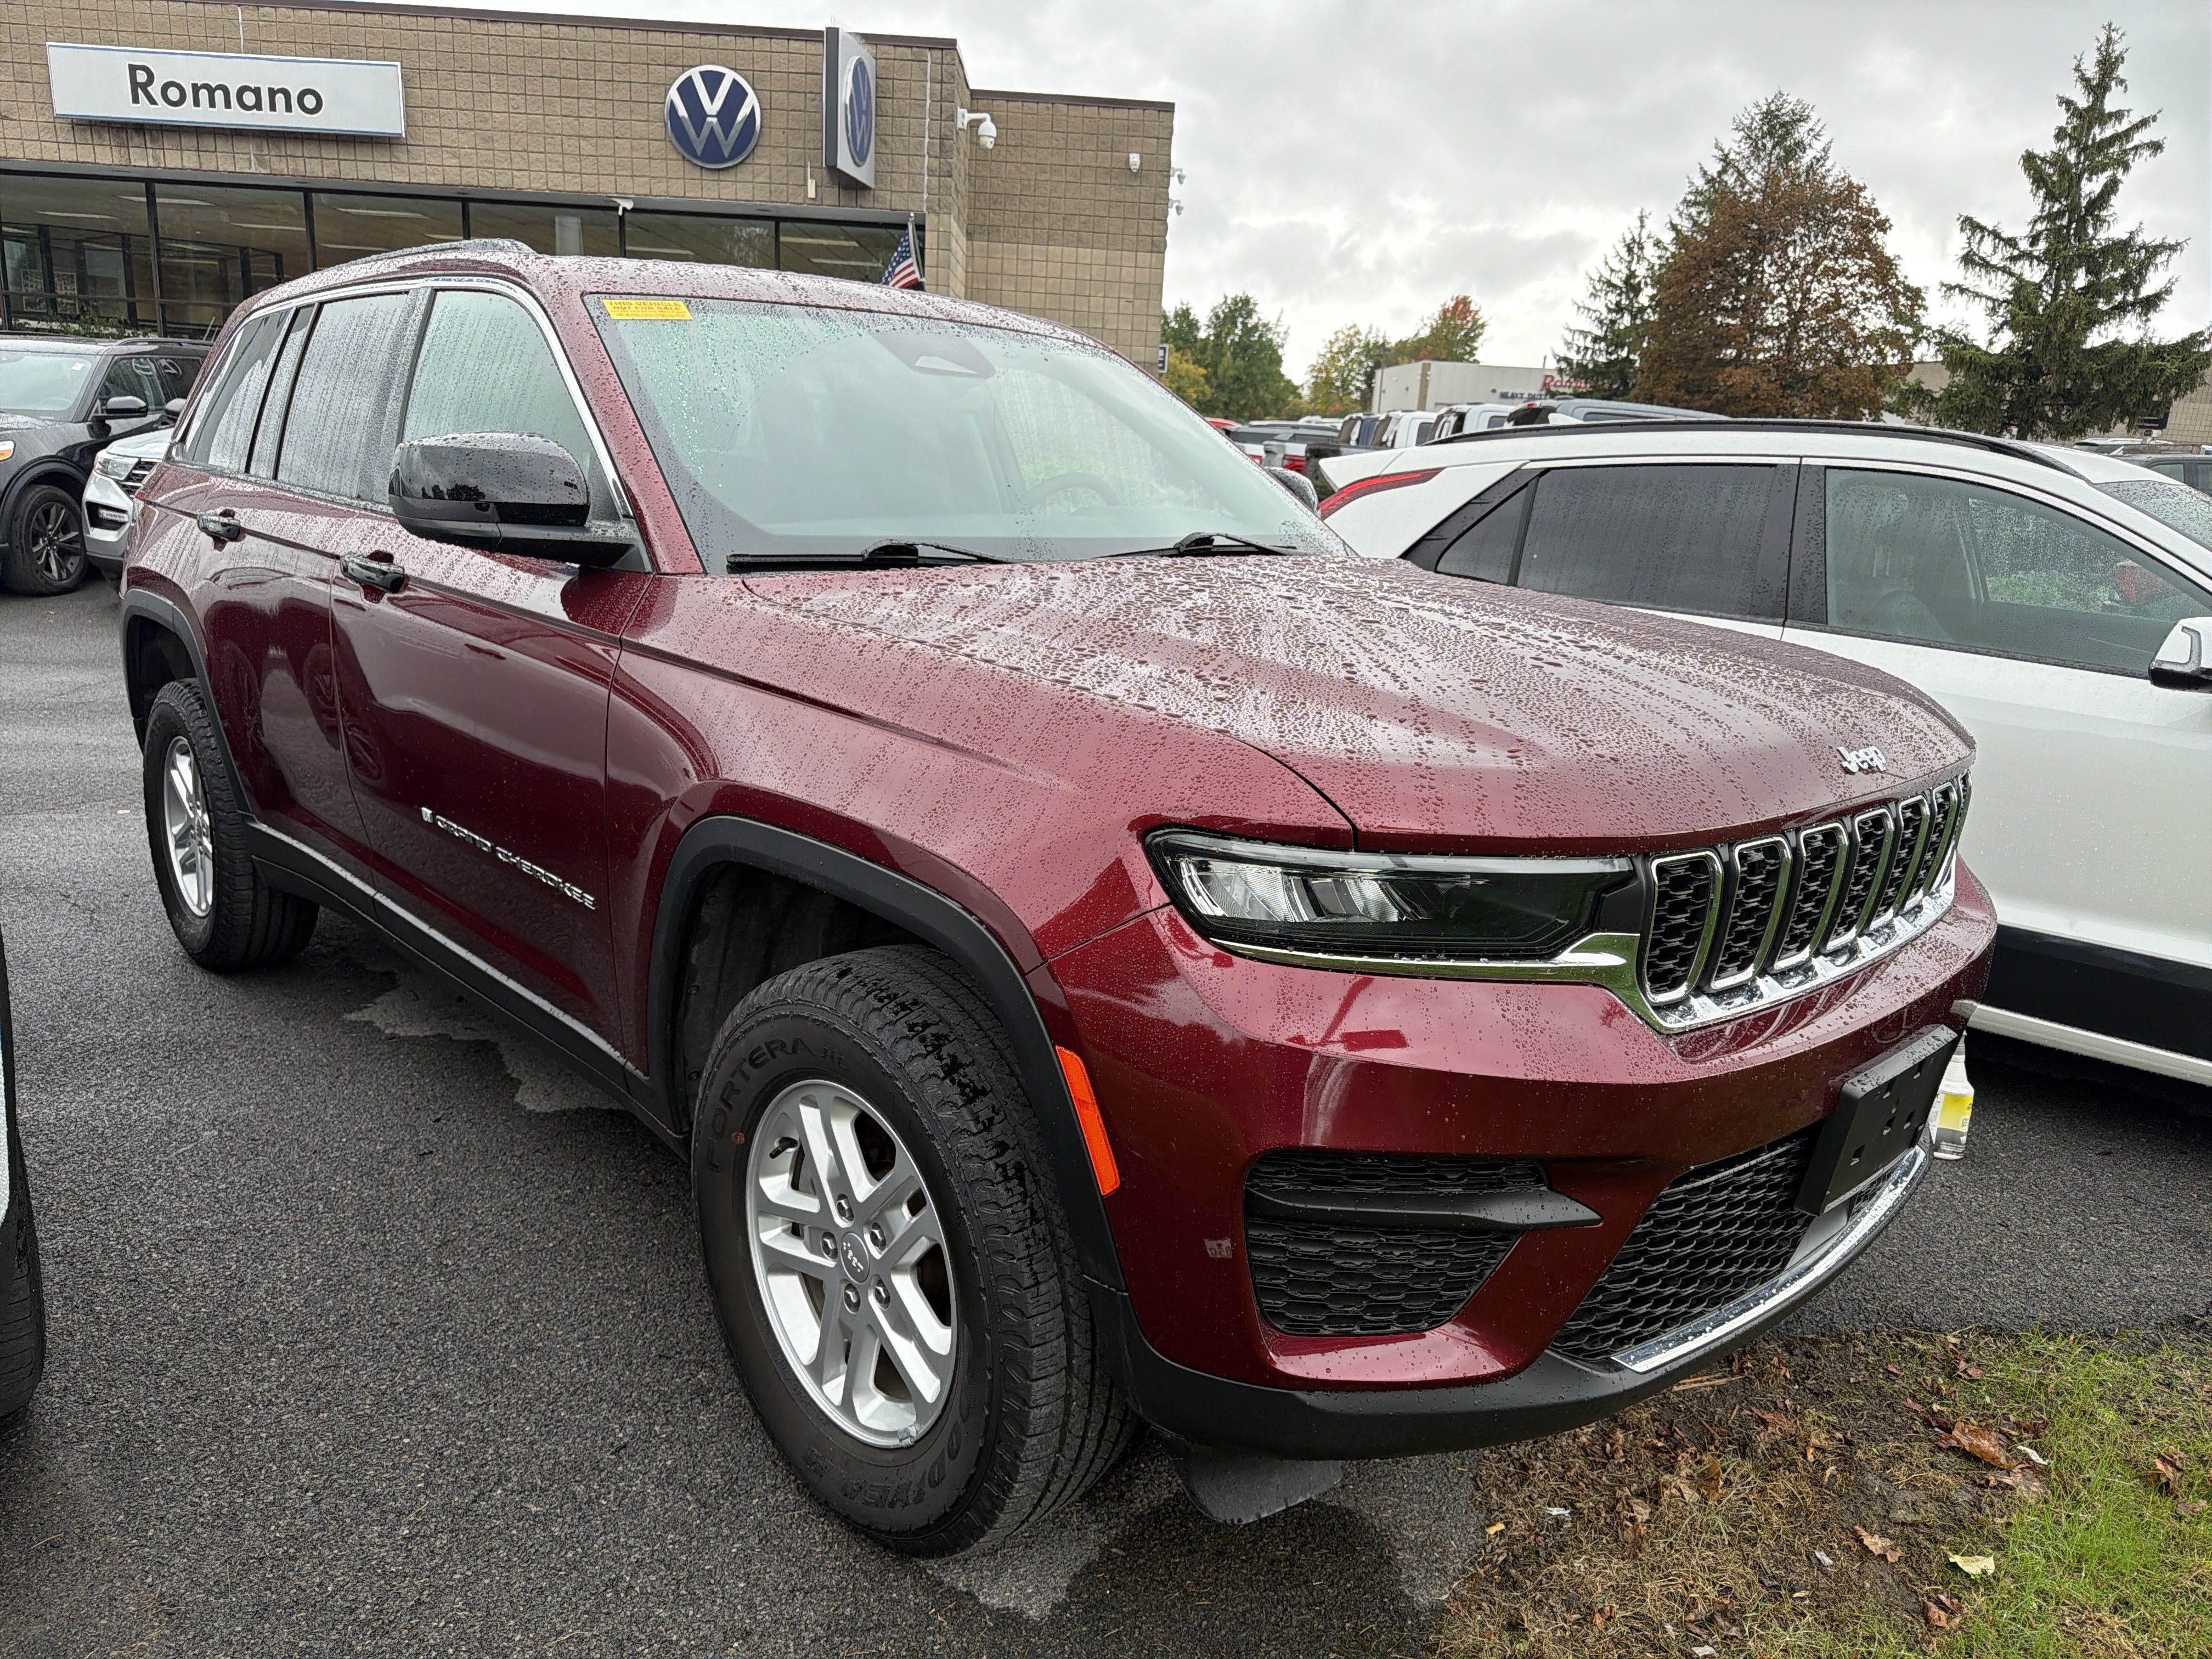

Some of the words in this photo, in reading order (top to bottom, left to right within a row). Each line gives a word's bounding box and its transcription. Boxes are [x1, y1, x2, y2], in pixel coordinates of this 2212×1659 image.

[127, 63, 324, 116] Romano
[1837, 746, 1887, 773] Jeep
[436, 815, 493, 853] GRAND
[495, 847, 598, 910] CHEROKEE
[706, 1037, 817, 1173] FORTERA
